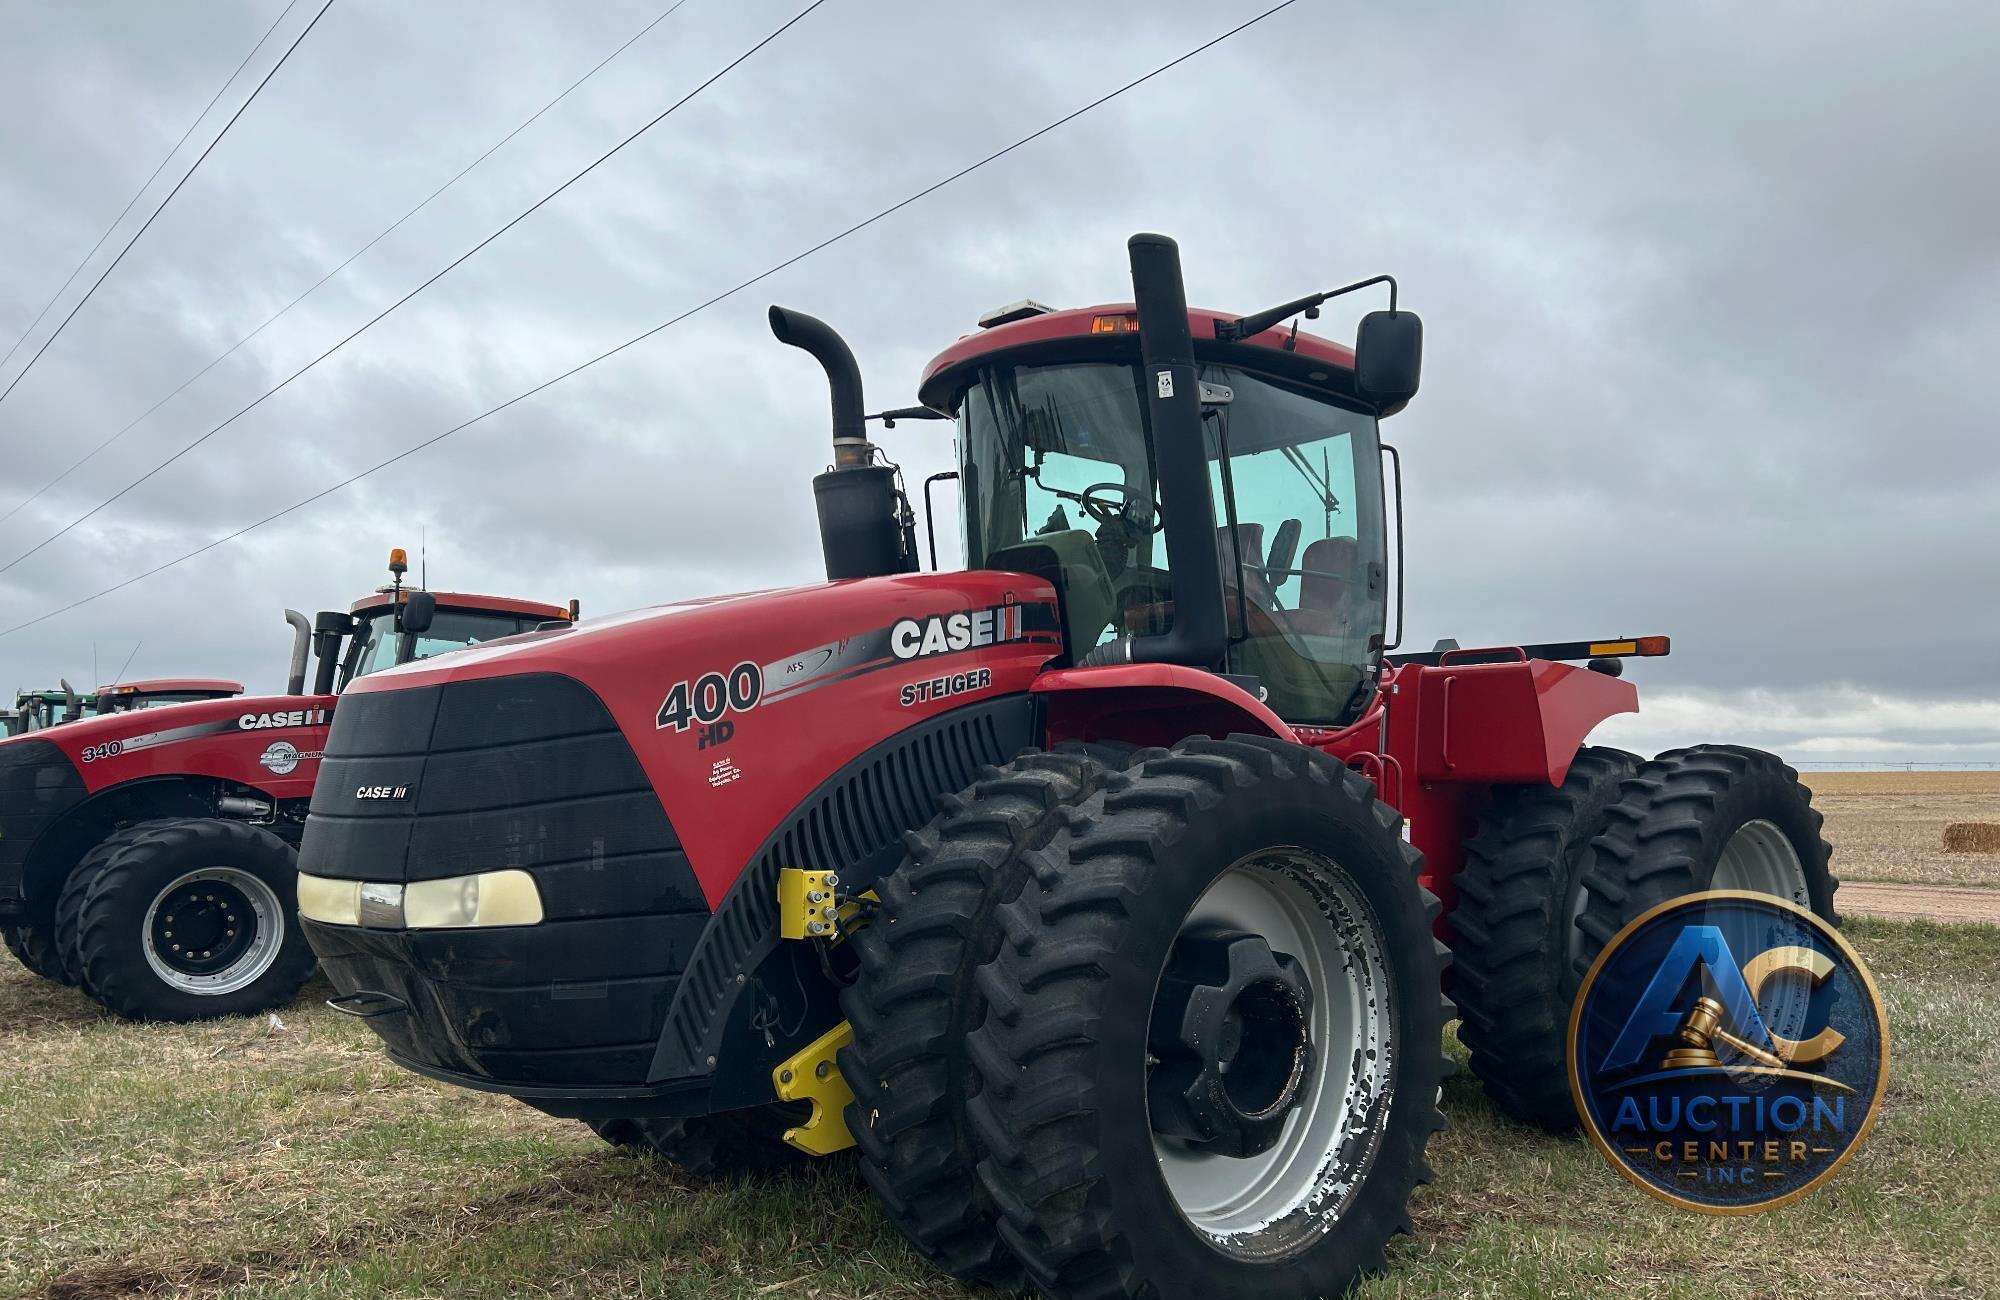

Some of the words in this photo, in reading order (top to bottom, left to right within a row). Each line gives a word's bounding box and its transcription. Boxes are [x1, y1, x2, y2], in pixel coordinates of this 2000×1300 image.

[891, 610, 993, 659] CASE
[786, 661, 804, 674] AFS
[656, 661, 763, 733] 400
[900, 667, 992, 707] STEIGER
[238, 711, 304, 730] CASE
[698, 720, 735, 751] HD
[82, 740, 122, 762] 340
[356, 786, 392, 799] CASE
